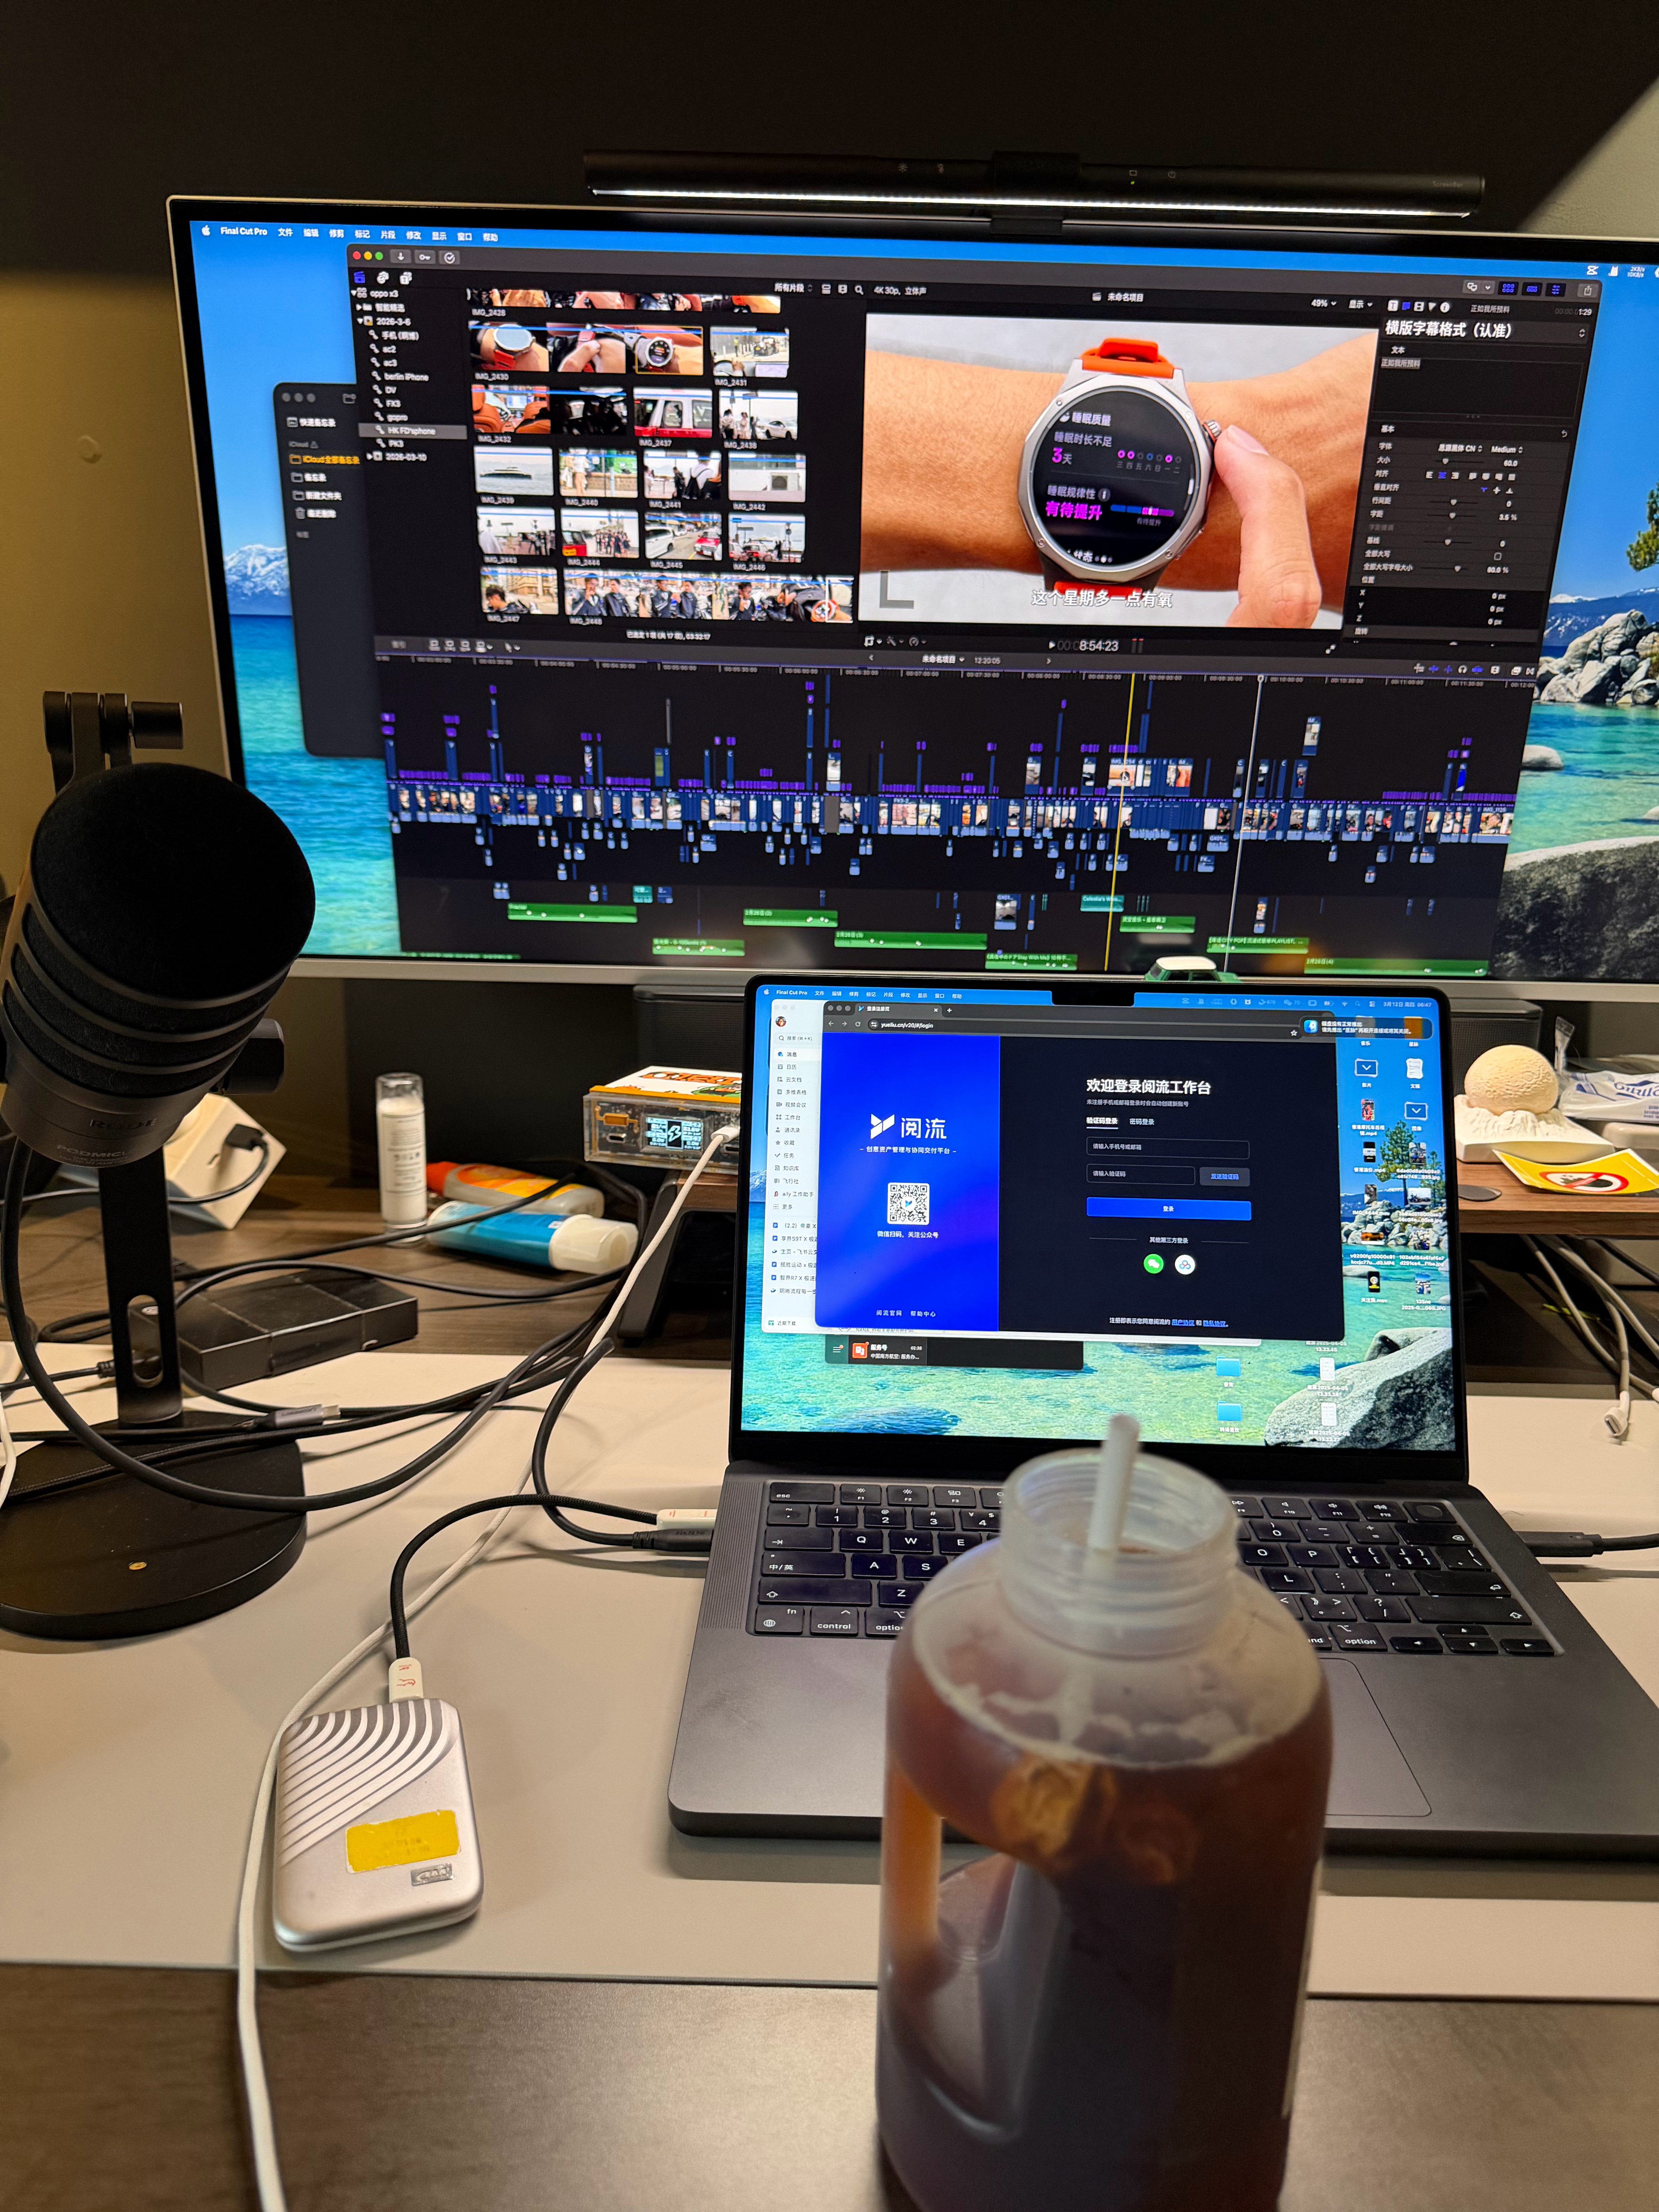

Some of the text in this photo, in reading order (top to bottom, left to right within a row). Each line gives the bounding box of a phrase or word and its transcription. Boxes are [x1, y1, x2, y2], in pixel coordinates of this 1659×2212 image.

[220, 227, 268, 236] Final Cut Pro
[278, 228, 293, 237] 文件
[304, 228, 319, 237] 编辑
[329, 229, 344, 238] 修剪
[355, 230, 370, 239] 标记
[381, 230, 395, 239] 片段
[406, 231, 421, 240] 修改
[432, 232, 447, 241] 显示
[457, 232, 472, 241] 窗口
[483, 233, 498, 242] 帮助
[775, 283, 804, 292] 所有片段
[905, 287, 927, 296] 立体声
[1108, 293, 1144, 302] 未命名项目
[1311, 299, 1328, 308] 49%
[1471, 305, 1510, 314] 正如我所预料
[1391, 345, 1405, 355] 文本
[1381, 358, 1420, 368] 正如我所预料
[714, 378, 747, 386] IMG_2431
[1072, 412, 1111, 426] 睡眠质量
[1054, 432, 1112, 447] 睡眠时长不足
[1374, 483, 1399, 491] 垂直对齐
[1047, 485, 1096, 500] 睡眠规律性
[1372, 496, 1391, 505] 行间距
[1046, 501, 1102, 521] 有待提升
[1032, 590, 1173, 608] 这个星期多一点有氧
[922, 655, 956, 664] 未命名项目
[1086, 1079, 1211, 1095] 欢迎登录阅流工作台
[901, 1117, 947, 1139] 阅流
[866, 1146, 950, 1154] 创意资产管理与协同交付平台
[877, 1230, 939, 1239] 微信扫码，关注公众号
